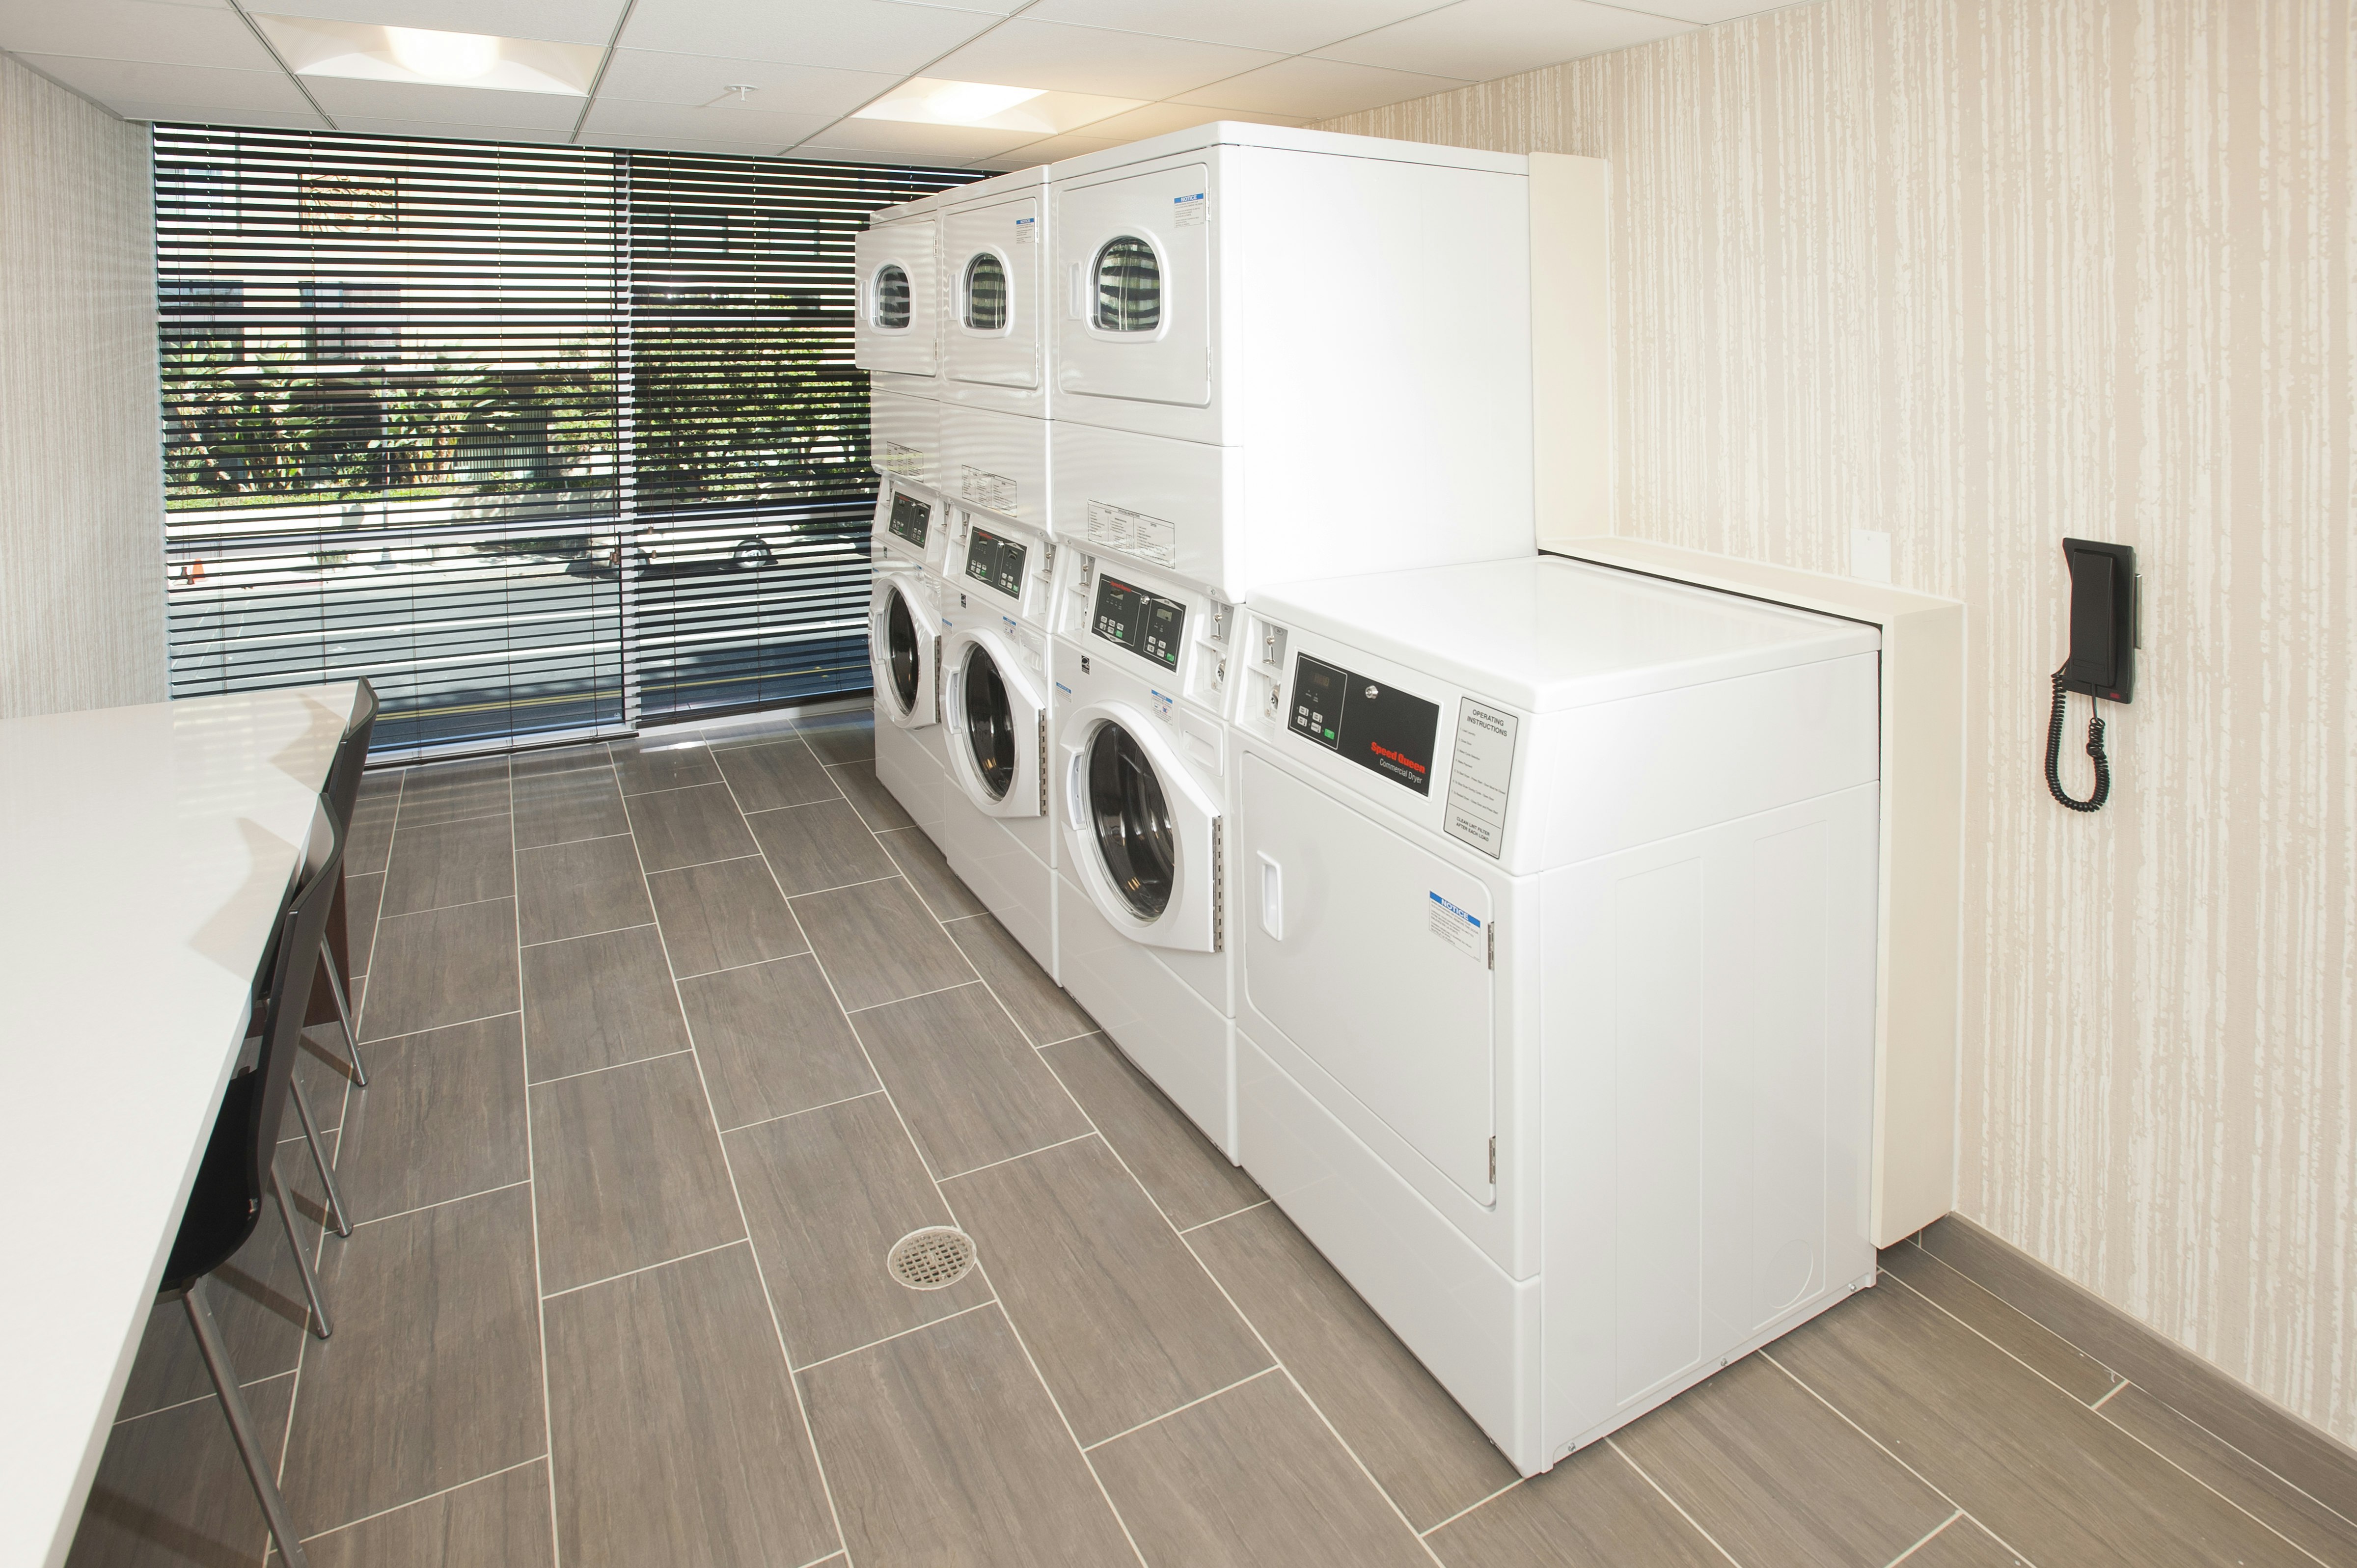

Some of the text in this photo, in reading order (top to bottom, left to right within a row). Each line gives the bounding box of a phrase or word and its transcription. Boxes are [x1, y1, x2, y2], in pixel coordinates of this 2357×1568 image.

[1467, 716, 1507, 737] INSTRUCTIONS
[1472, 709, 1504, 726] OPERATING
[1370, 741, 1425, 774] Speed Queen
[1379, 758, 1423, 784] Commercial Dryer
[1456, 816, 1469, 825] CLEAN
[1478, 827, 1490, 836] FILTER
[1456, 822, 1468, 831] AFTER
[1441, 899, 1469, 920] NOTICE
